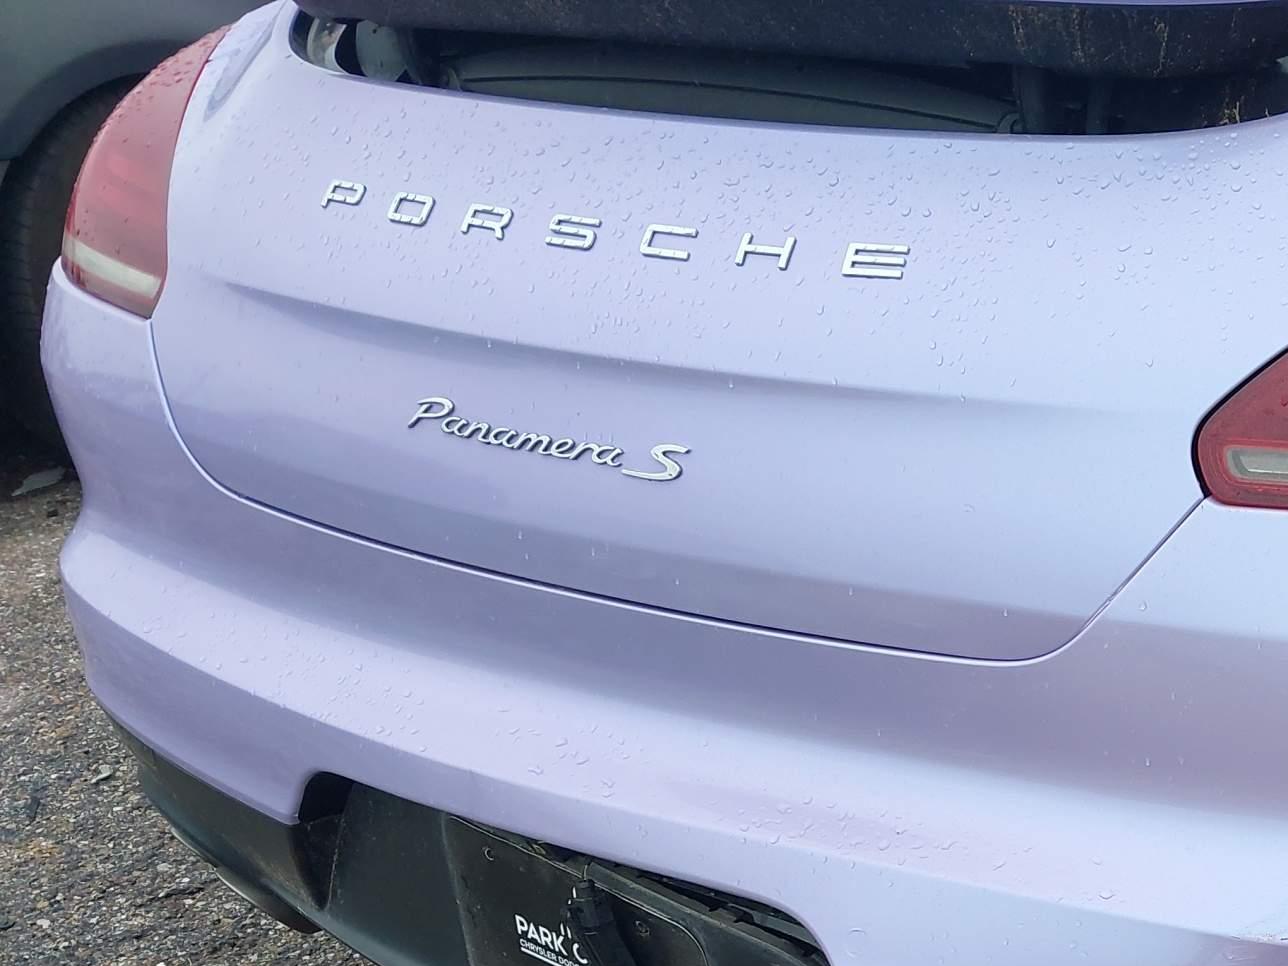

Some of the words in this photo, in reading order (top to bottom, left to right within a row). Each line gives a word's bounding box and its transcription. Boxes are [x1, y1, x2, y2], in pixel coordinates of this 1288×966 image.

[321, 178, 911, 280] PORSCHE
[407, 396, 623, 469] Panamera
[621, 443, 692, 482] S
[514, 913, 568, 957] PARK
[519, 938, 557, 962] CHRYSLER
